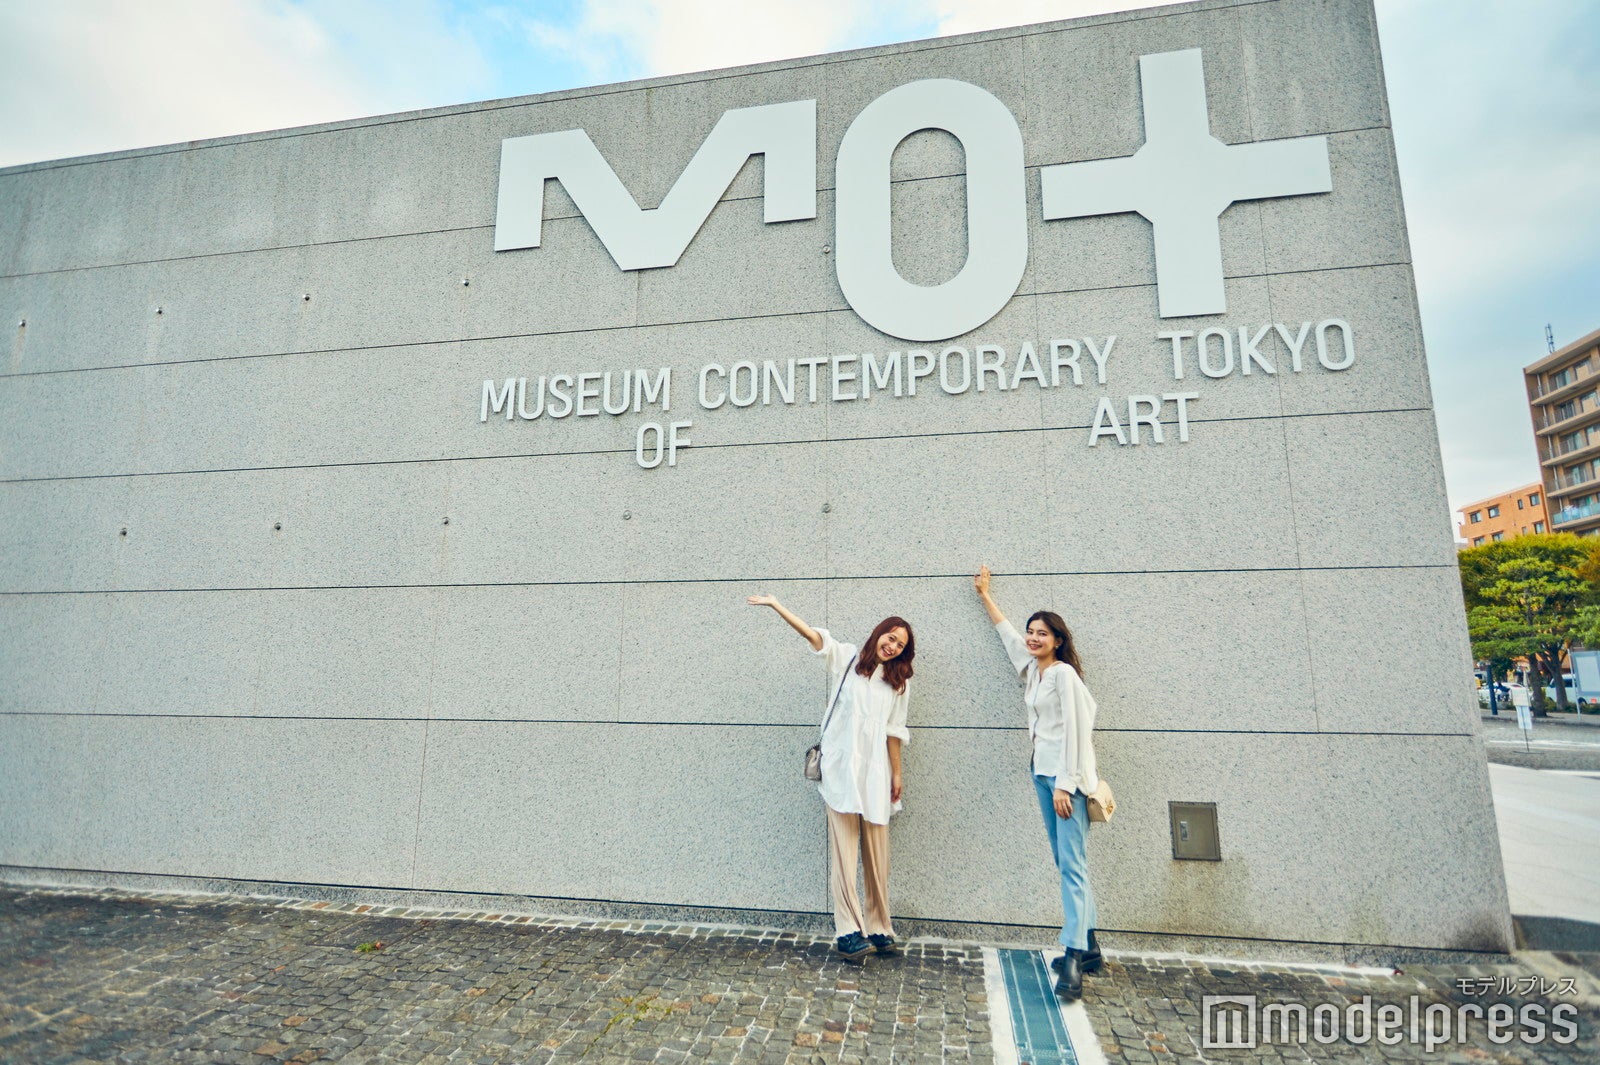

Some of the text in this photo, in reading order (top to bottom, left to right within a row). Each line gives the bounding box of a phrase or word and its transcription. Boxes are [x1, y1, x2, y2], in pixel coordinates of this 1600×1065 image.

[480, 318, 1356, 423] MUSEUM CONTEMPORARY TOKYO
[635, 391, 1199, 470] OF ART
